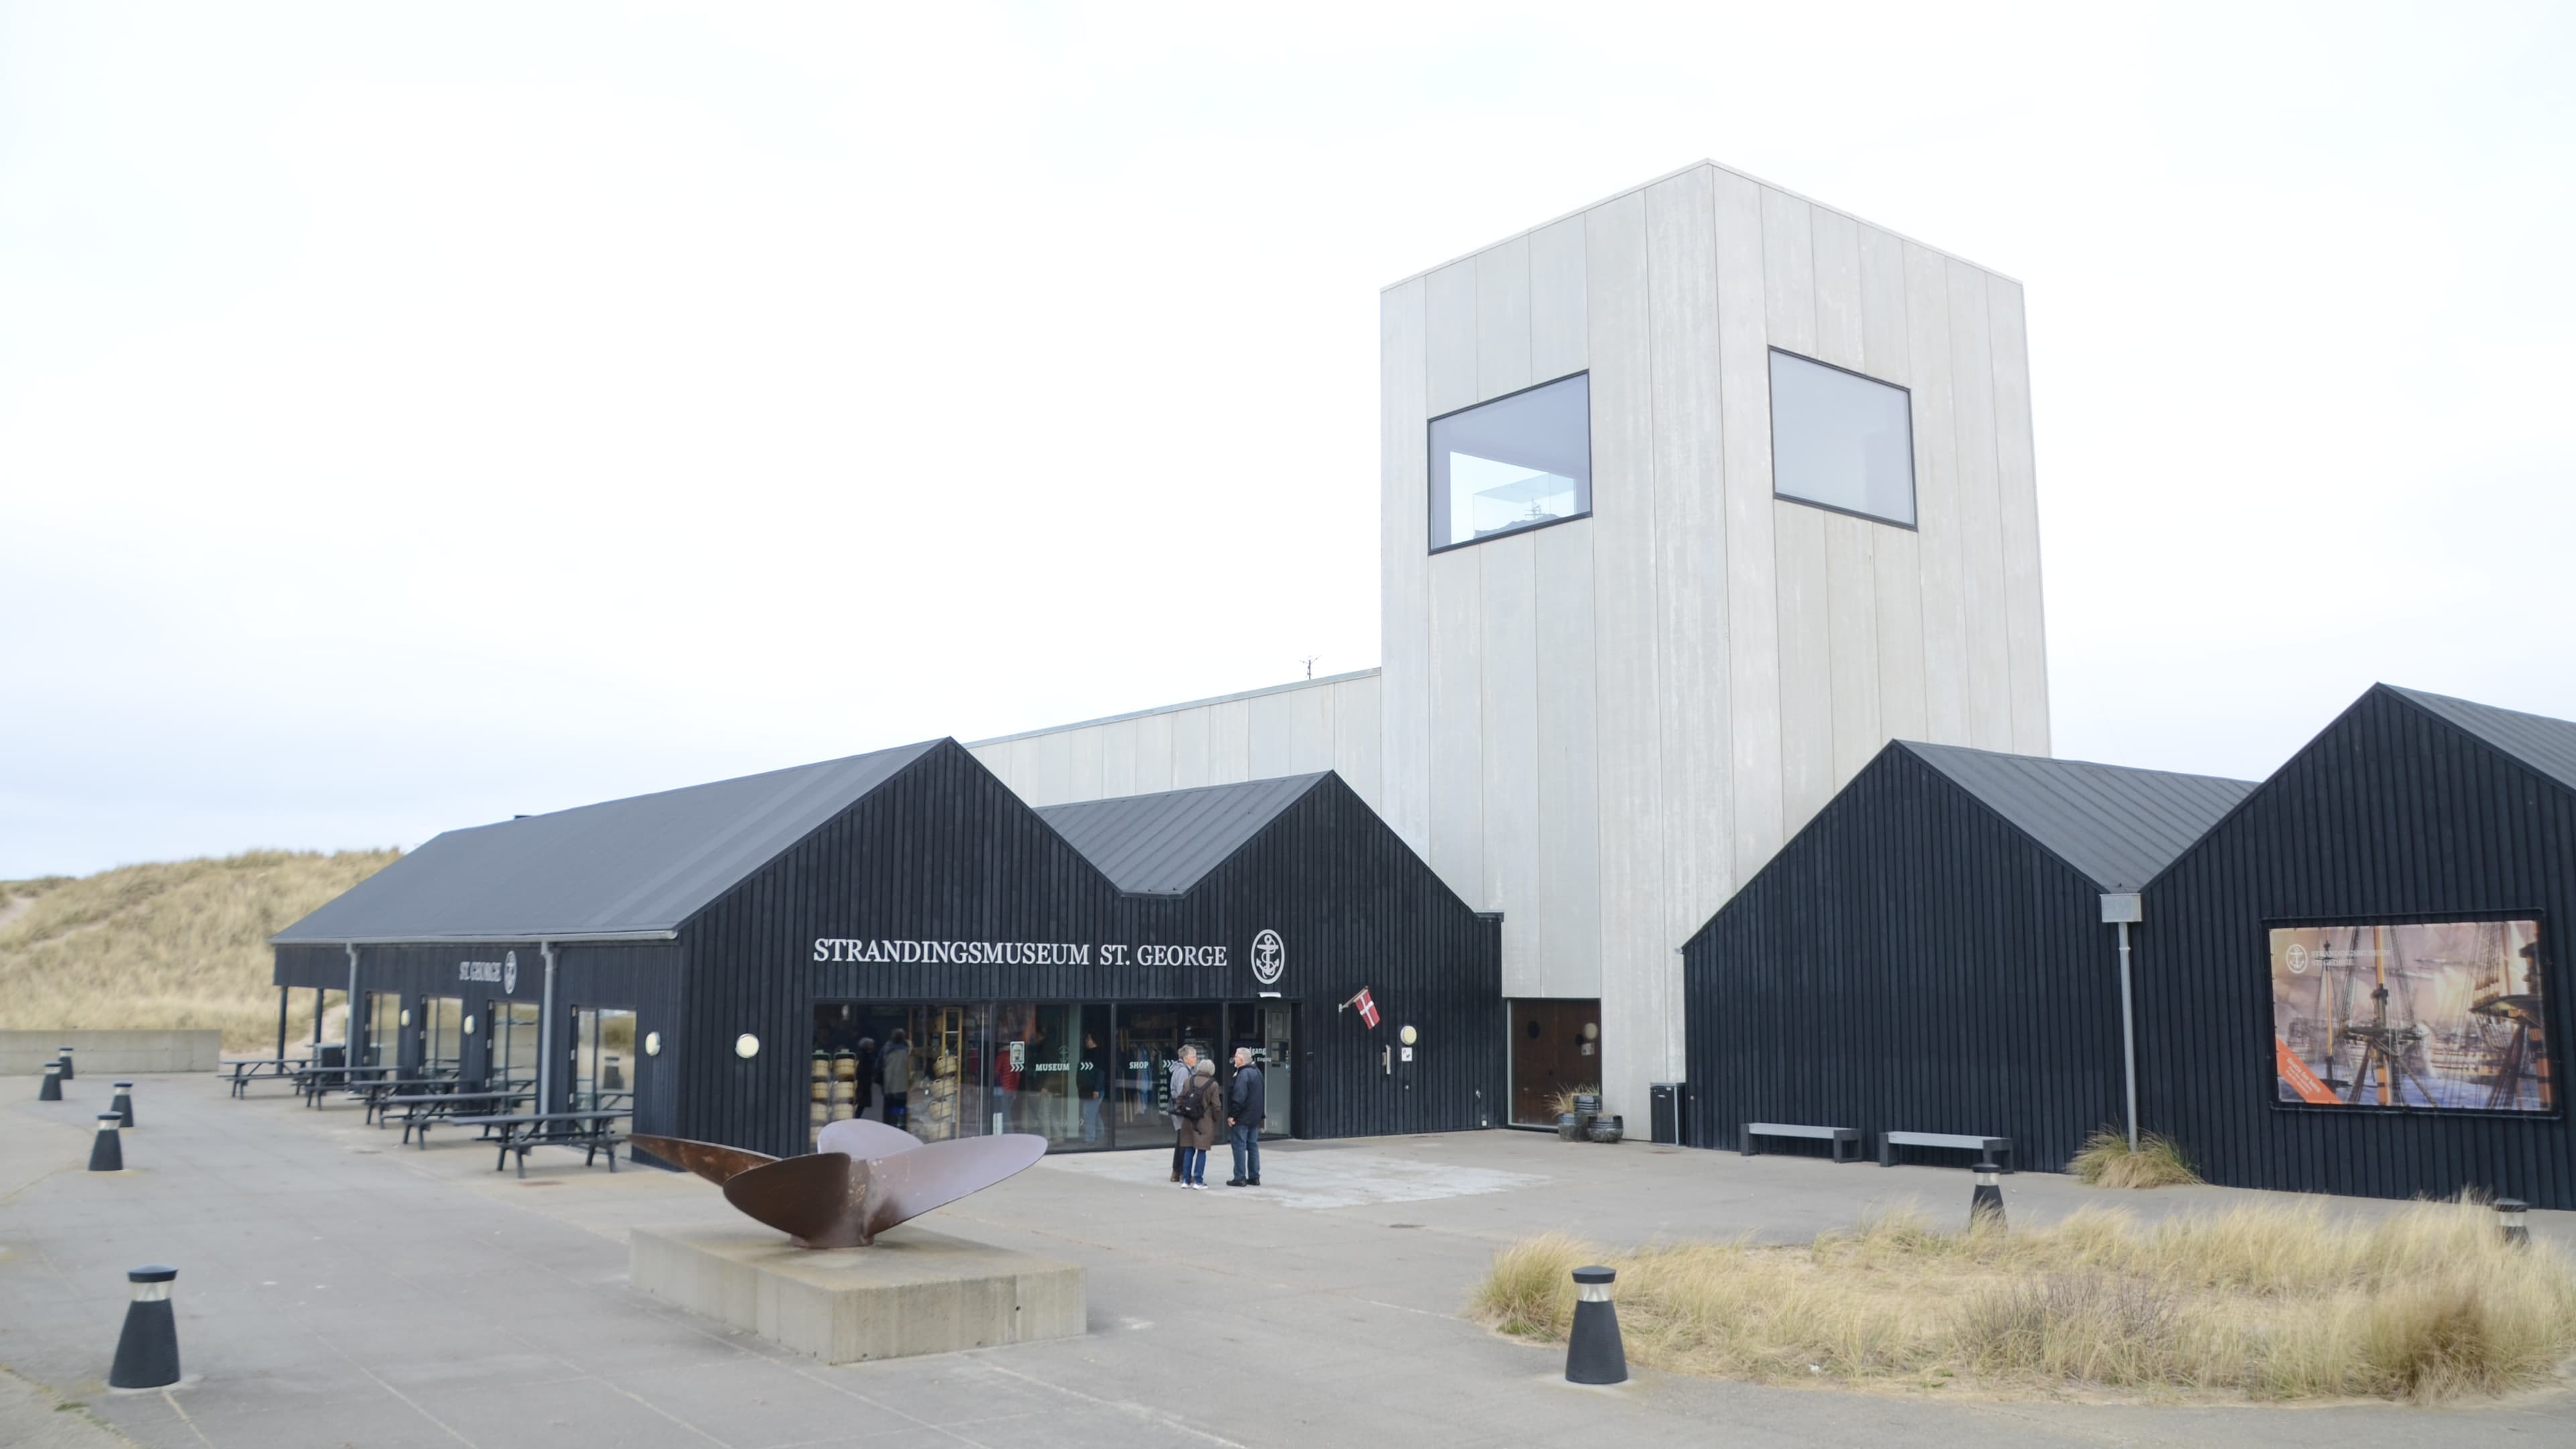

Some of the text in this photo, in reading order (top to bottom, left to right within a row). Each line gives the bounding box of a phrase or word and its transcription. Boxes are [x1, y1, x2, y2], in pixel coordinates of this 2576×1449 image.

[813, 938, 1228, 967] STRANDINGSMUSEUM ST. GEORGE
[1035, 1063, 1071, 1072] MUSEUM
[1129, 1061, 1149, 1069] SHOP
